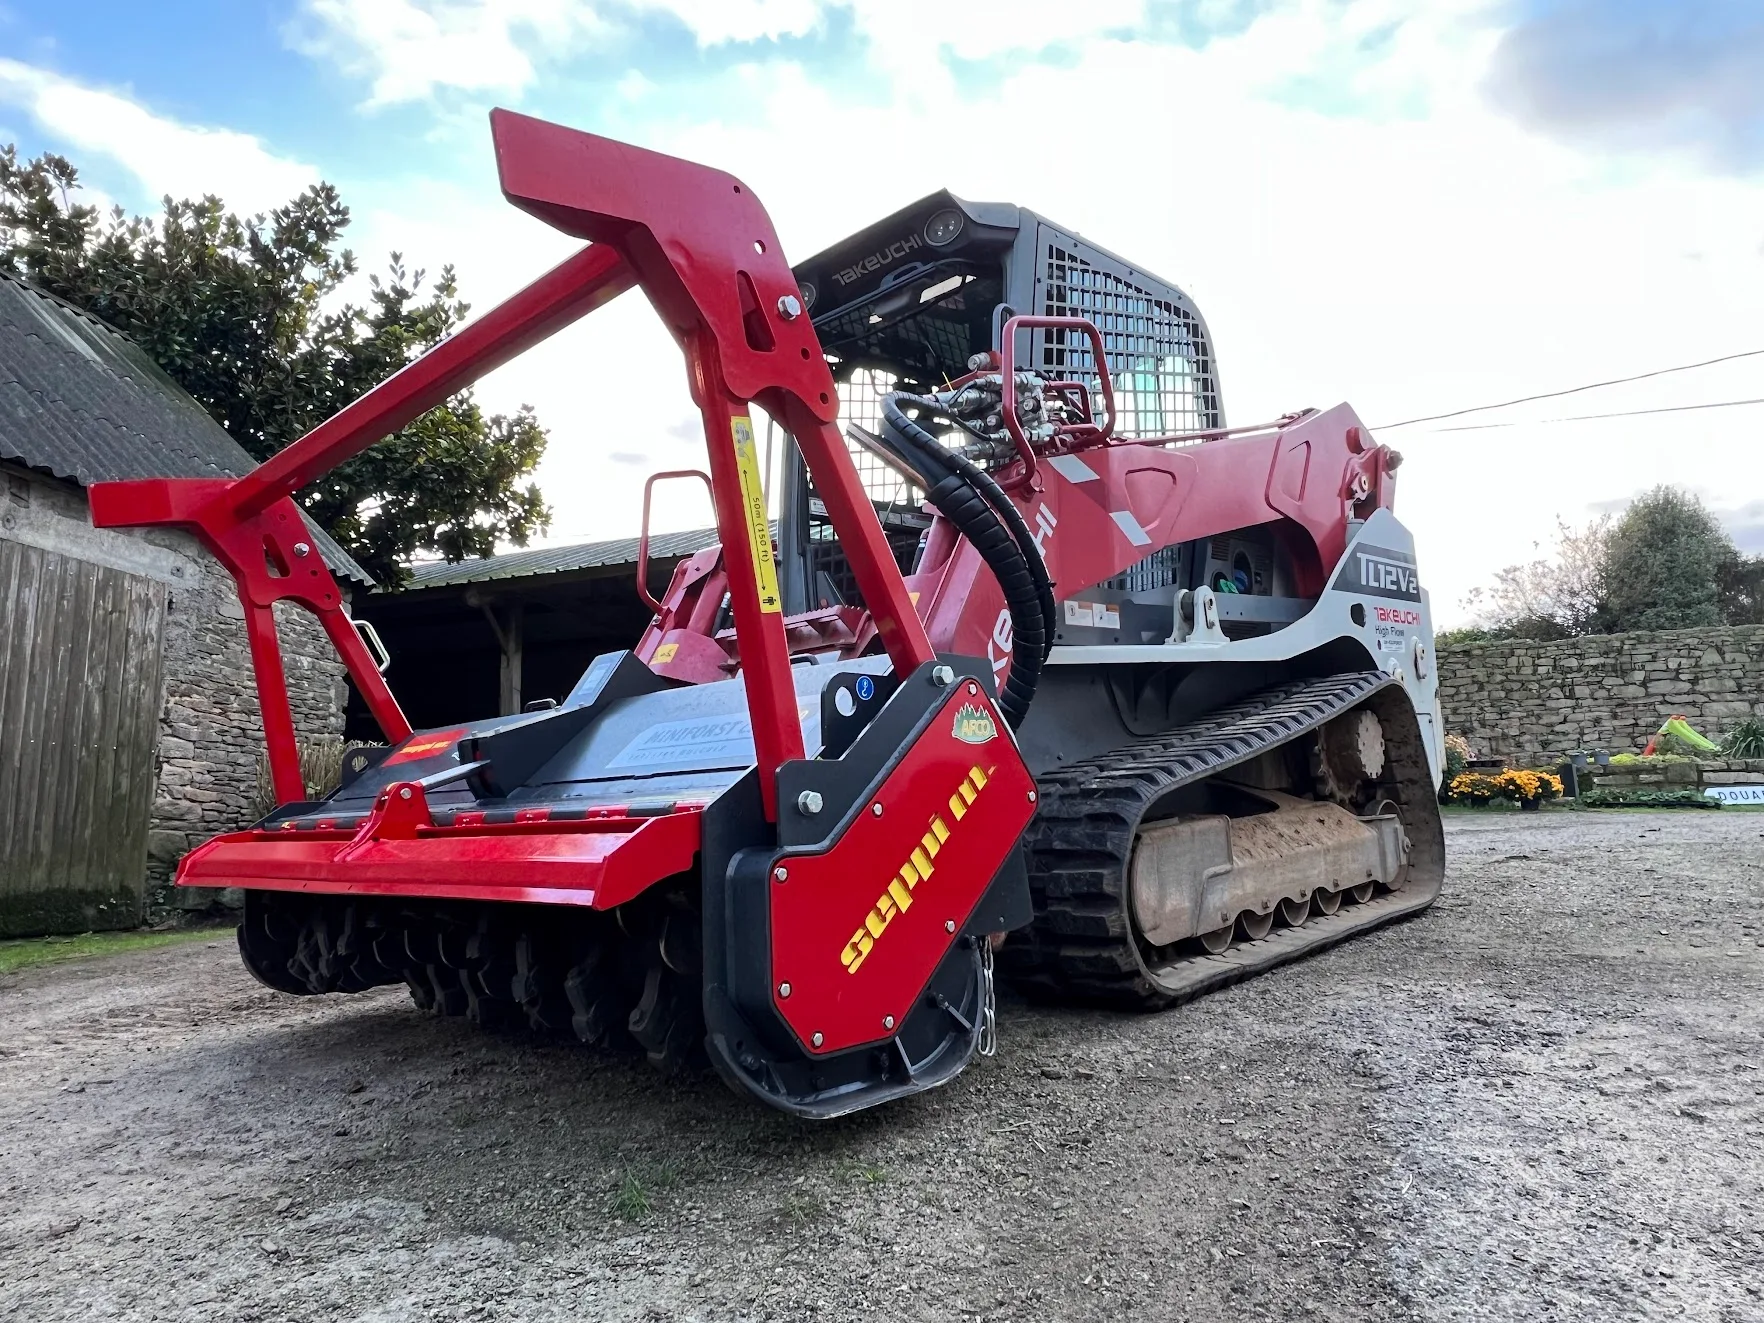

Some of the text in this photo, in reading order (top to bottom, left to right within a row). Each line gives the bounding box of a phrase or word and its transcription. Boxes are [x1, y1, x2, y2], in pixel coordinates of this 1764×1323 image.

[752, 497, 769, 562] 50m (150 ft)
[1357, 553, 1417, 593] TL12V2
[1375, 625, 1389, 638] High
[1717, 790, 1764, 801] DOUA
[840, 812, 951, 975] seppi
